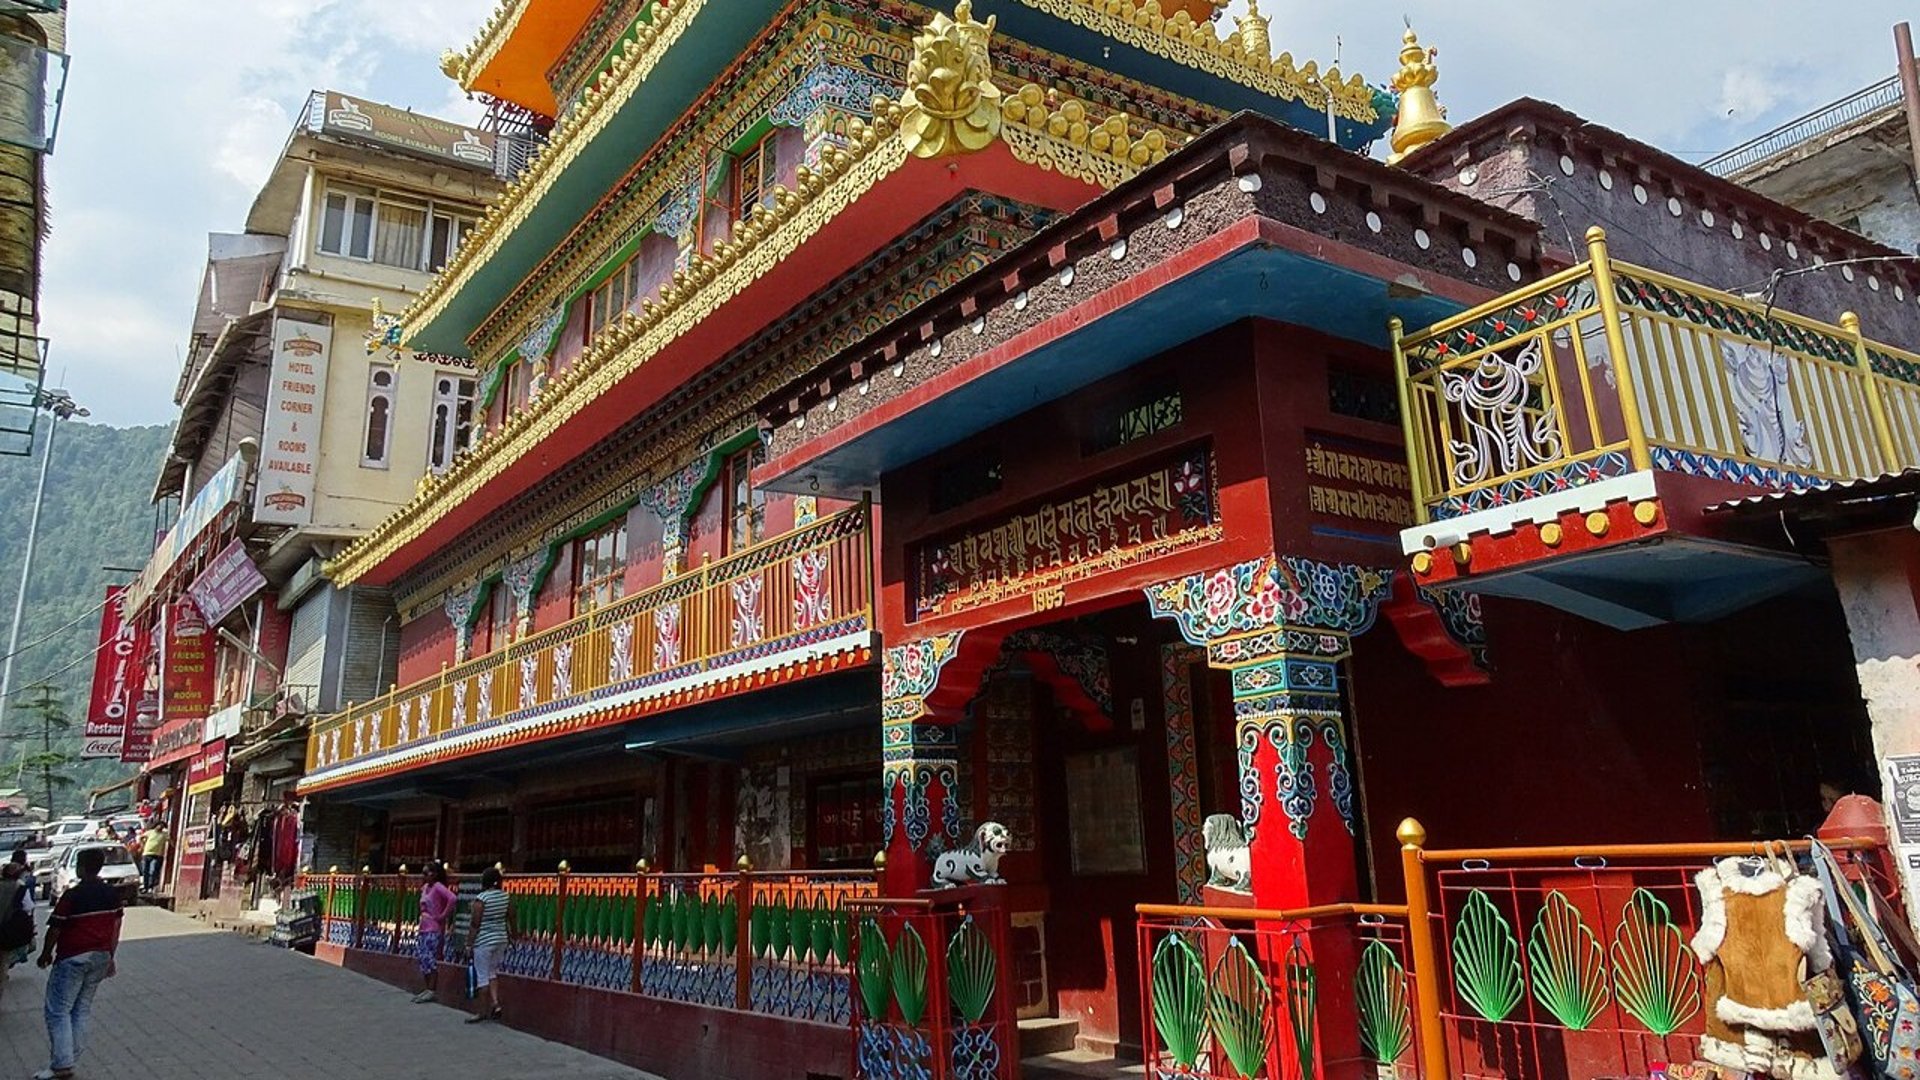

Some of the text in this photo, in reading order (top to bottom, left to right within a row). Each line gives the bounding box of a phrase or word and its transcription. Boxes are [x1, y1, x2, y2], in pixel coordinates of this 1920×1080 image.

[374, 131, 447, 154] ROOMS AVAILABLE
[288, 362, 314, 375] HOTEL
[282, 380, 316, 395] FRIENDS
[280, 400, 313, 414] CORNER
[291, 421, 298, 432] &
[278, 440, 306, 453] ROOMS
[268, 460, 311, 474] AVAILABLE
[173, 665, 205, 673] CORNER
